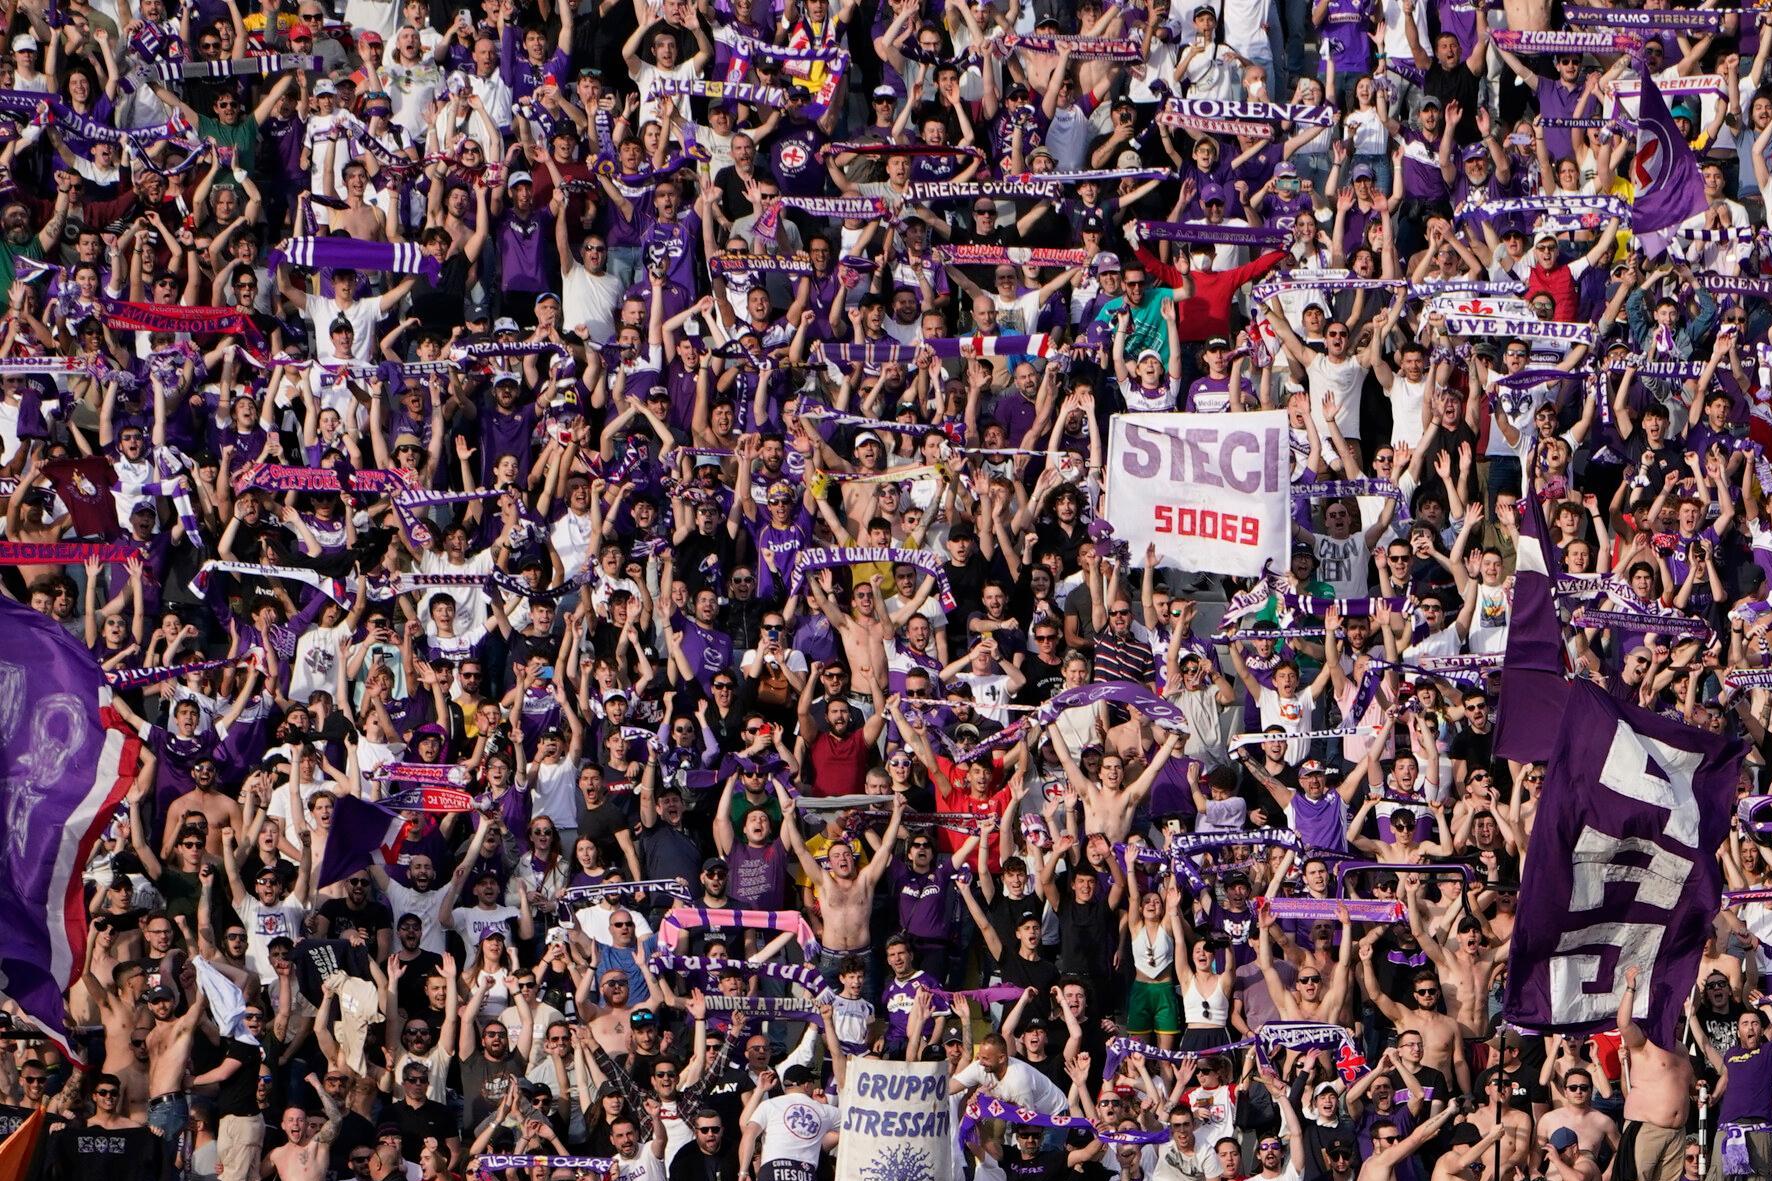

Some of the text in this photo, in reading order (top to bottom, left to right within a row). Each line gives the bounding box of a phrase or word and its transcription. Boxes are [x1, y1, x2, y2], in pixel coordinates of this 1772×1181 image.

[1606, 13, 1650, 24] SIAMO
[1653, 14, 1706, 26] FIRENZE
[1521, 30, 1615, 47] FIORENTINA
[1633, 76, 1723, 91] FRENTINA
[1168, 97, 1336, 124] FIORENZA
[916, 180, 1056, 200] FIRENZE OVUNQUE
[1446, 318, 1593, 342] UVE MERDA
[1153, 502, 1260, 547] 50069
[1108, 1036, 1199, 1060] FIRENZE
[856, 1071, 947, 1102] GRUPPO
[478, 1154, 529, 1167] SICIL
